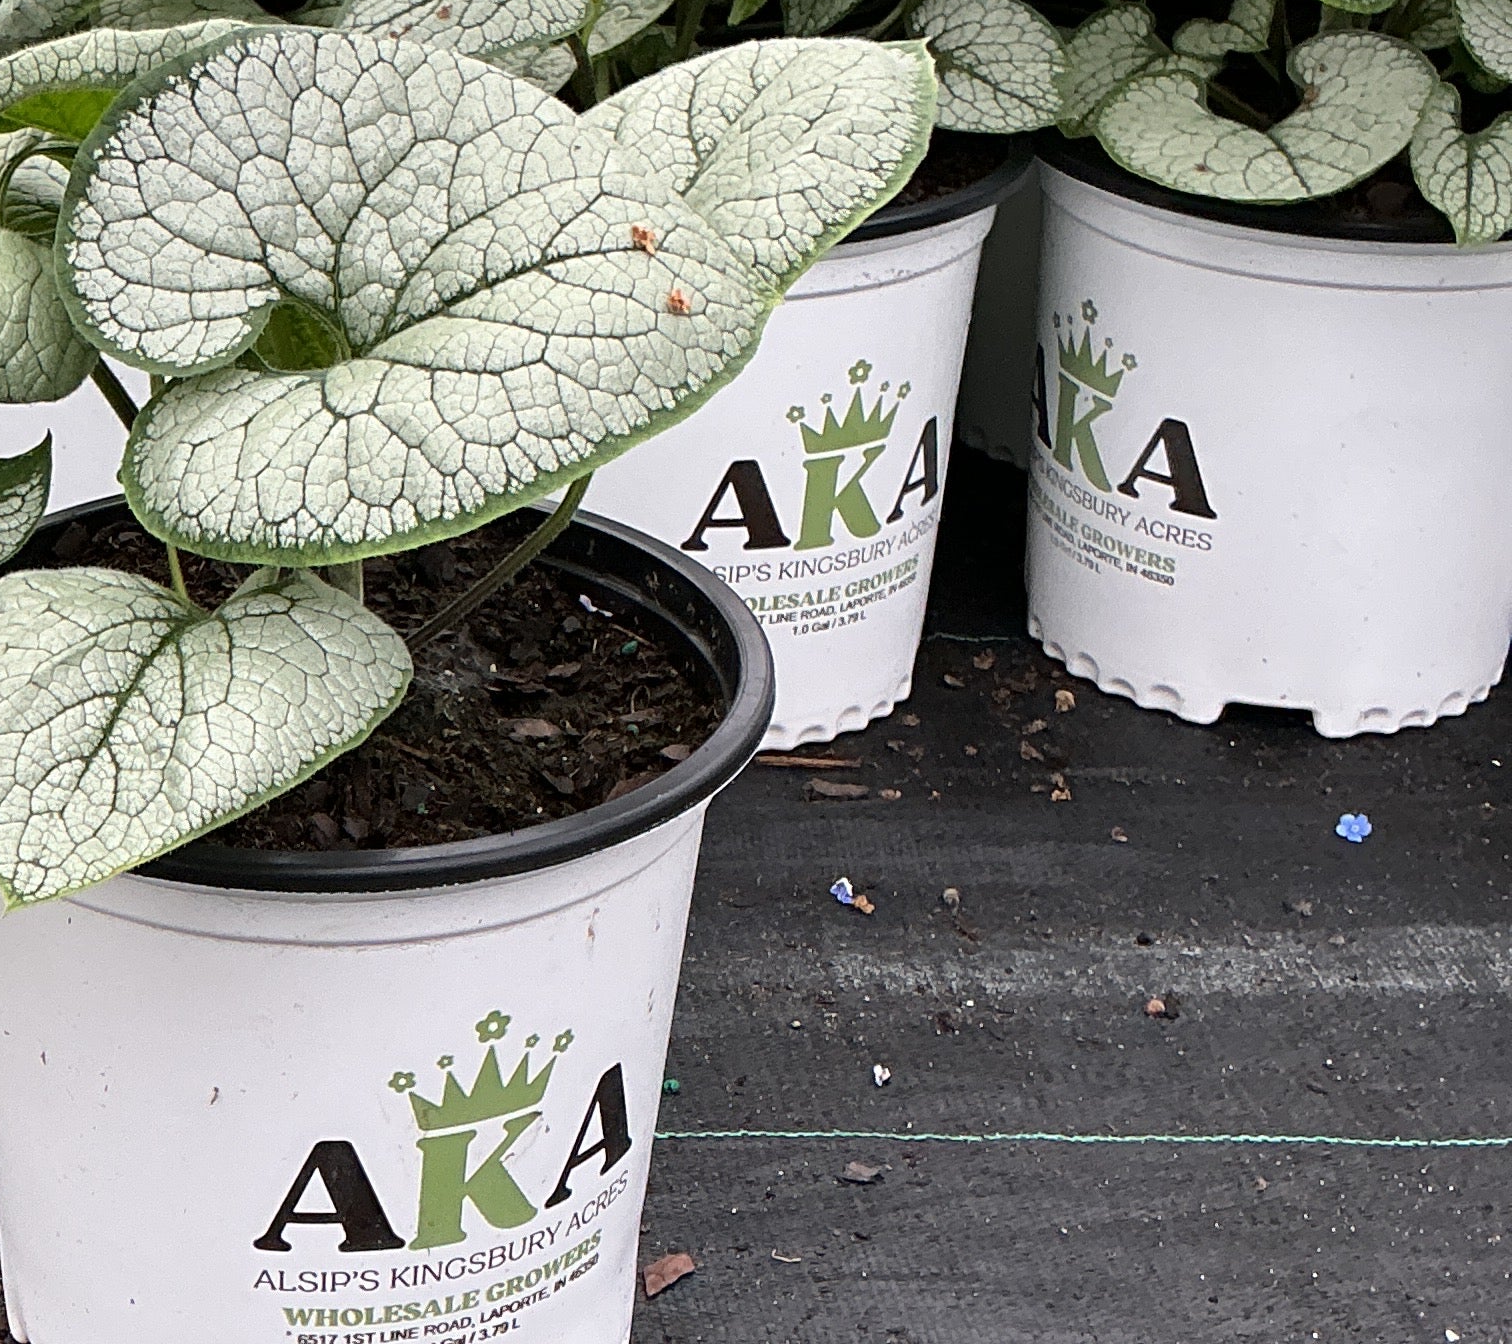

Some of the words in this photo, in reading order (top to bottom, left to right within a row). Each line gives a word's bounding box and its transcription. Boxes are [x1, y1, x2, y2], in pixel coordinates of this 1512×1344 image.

[680, 415, 939, 551] AKA
[712, 563, 772, 583] SIP'S
[778, 535, 897, 580] KINGSBURY
[1080, 522, 1176, 573] GROWERS
[1134, 516, 1213, 551] ACRES
[744, 586, 842, 612] OLESALE
[844, 553, 919, 598] GROWERS
[769, 612, 798, 624] LINE
[253, 1062, 632, 1254] AKA
[253, 1269, 380, 1293] ALSIP'S
[390, 1220, 563, 1290] KINGSBURY
[564, 1169, 629, 1237] ACRES
[282, 1288, 480, 1327] WHOLESALE
[486, 1228, 603, 1303] GROWERS
[343, 1331, 376, 1344] 1ST
[379, 1325, 420, 1344] LINE
[423, 1316, 476, 1337] ROAD,
[479, 1286, 550, 1324] LAPORTE,
[553, 1274, 567, 1293] IN
[511, 1317, 521, 1329] L
